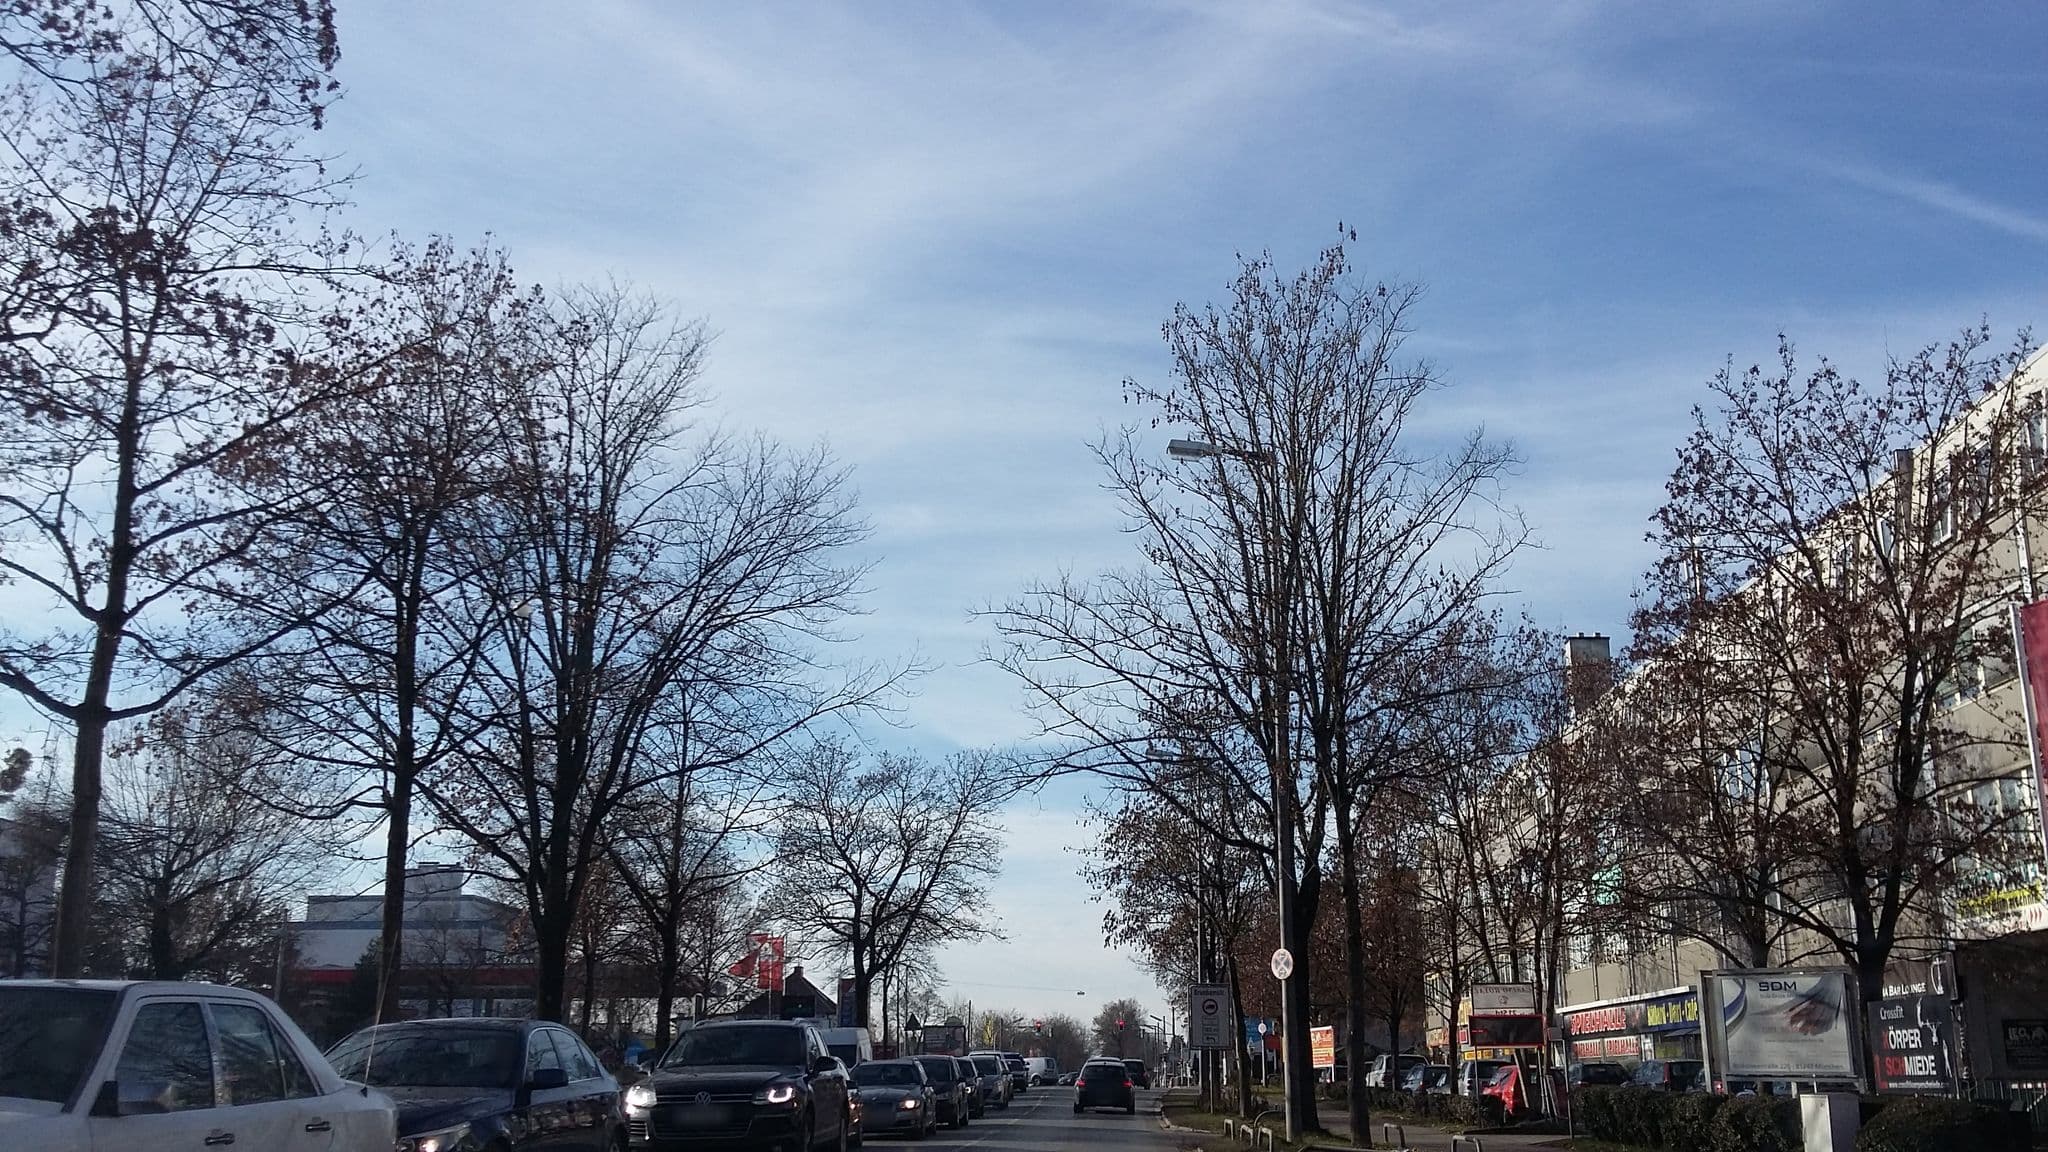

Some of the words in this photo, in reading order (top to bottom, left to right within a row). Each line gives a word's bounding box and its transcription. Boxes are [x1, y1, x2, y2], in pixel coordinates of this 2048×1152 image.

[1758, 981, 1797, 992] SDM
[1888, 984, 1901, 997] BAR
[1571, 1007, 1626, 1036] SPIELHALLE
[1883, 1026, 1922, 1049] KÖRPER
[1885, 1055, 1937, 1076] SCHMIEDE
